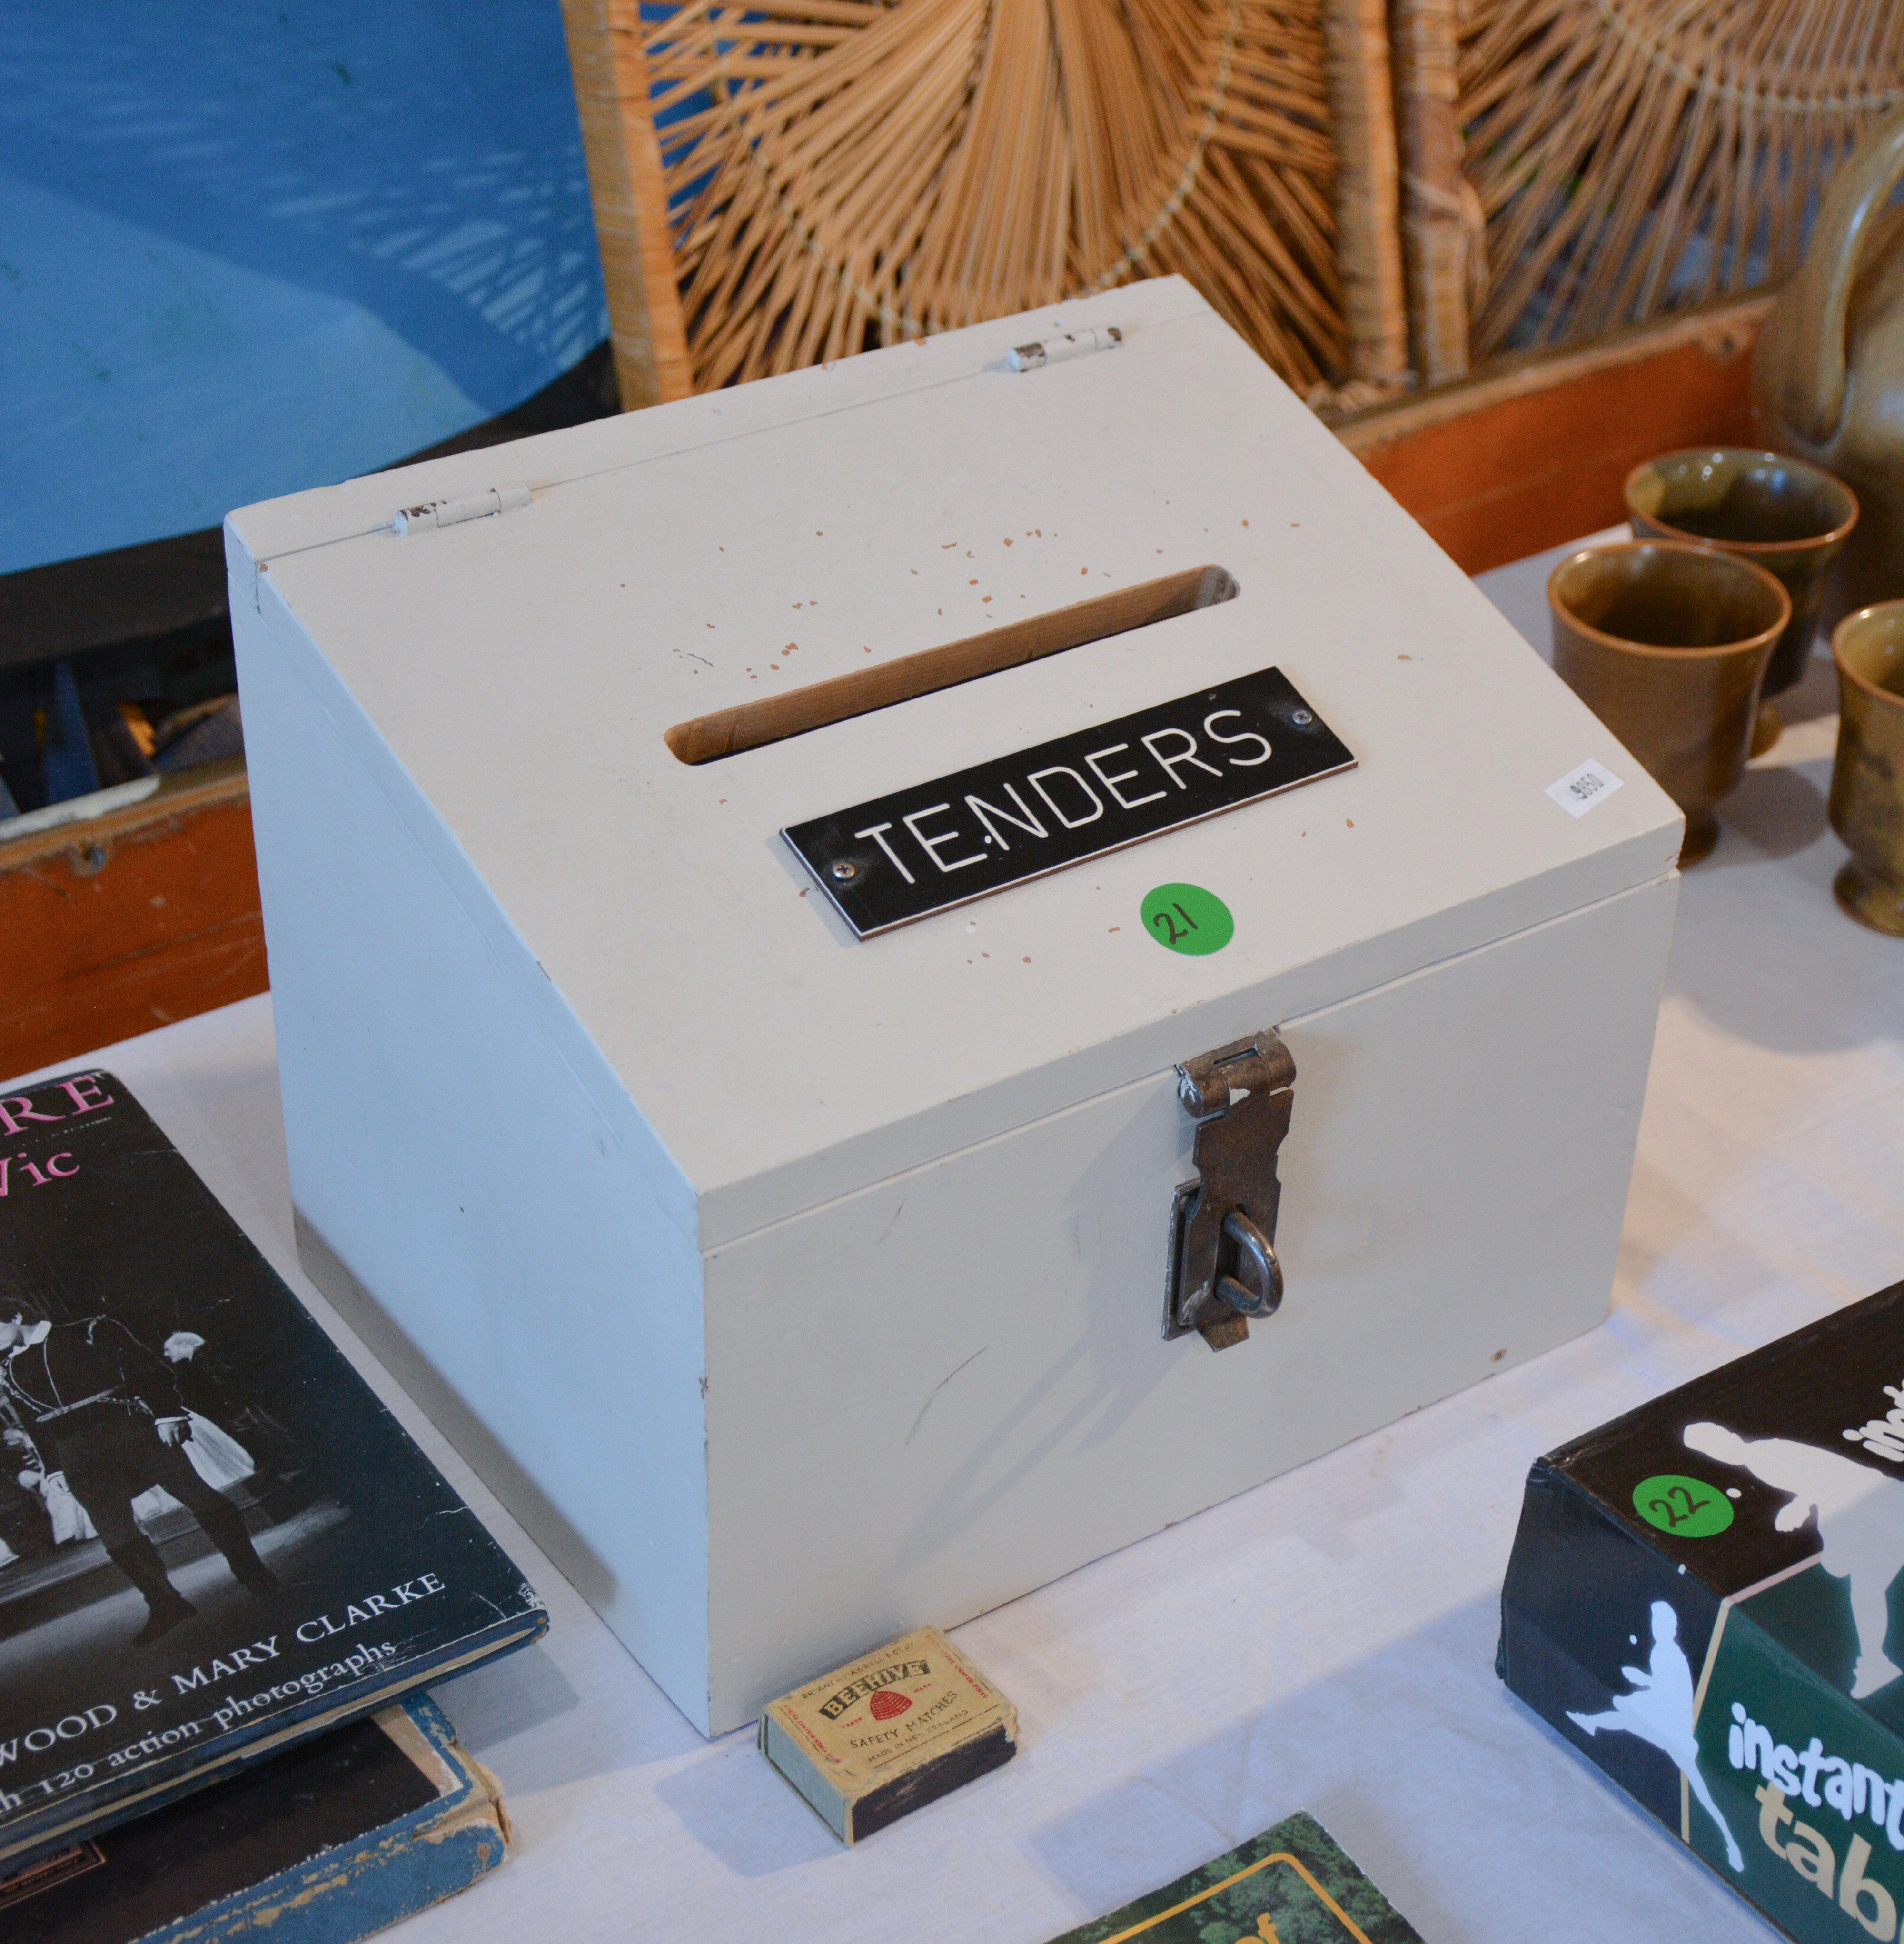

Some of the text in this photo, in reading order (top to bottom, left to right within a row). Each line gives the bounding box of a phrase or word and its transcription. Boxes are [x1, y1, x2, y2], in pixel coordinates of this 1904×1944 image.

[854, 709, 1272, 884] TENDERS
[1153, 903, 1198, 945] 21
[0, 1075, 115, 1136] RE
[1649, 1486, 1711, 1528] 22
[133, 1689, 162, 1710] &
[171, 1635, 281, 1695] MARY
[296, 1573, 446, 1642] CLARKE
[822, 1661, 926, 1717] BEEHIVE
[842, 1683, 932, 1729] TRADE MARK
[955, 1665, 974, 1684] LIGHTED
[972, 1684, 988, 1698] FIRES
[38, 1765, 94, 1794] 120
[108, 1722, 203, 1767] action
[213, 1642, 396, 1732] photographs
[850, 1691, 957, 1748] SAFETY MATCHES
[868, 1748, 893, 1762] MADE
[894, 1741, 904, 1749] IN
[926, 1709, 969, 1734] ZEALAND
[1729, 1702, 1904, 1851] instant
[1755, 1781, 1904, 1943] tab
